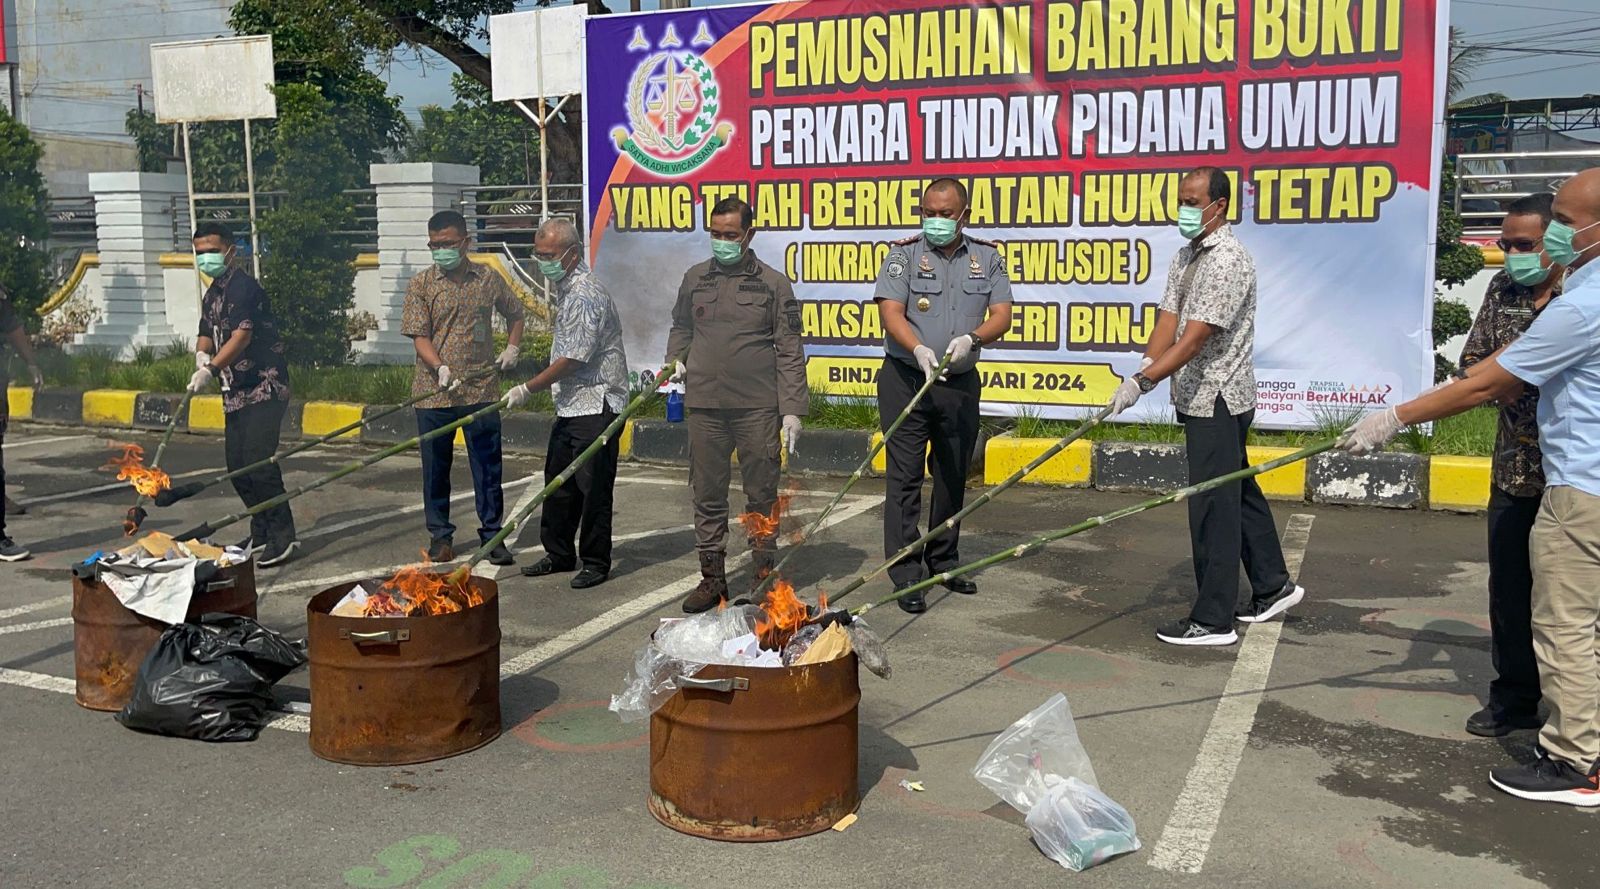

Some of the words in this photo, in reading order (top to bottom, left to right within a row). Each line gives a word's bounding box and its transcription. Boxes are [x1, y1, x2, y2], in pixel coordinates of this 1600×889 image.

[751, 5, 1031, 89] PEMUSNAHAN
[1048, 0, 1236, 73] BARANG
[1253, 0, 1399, 59] BUKTI
[752, 102, 909, 165] PERKARA
[920, 94, 1058, 160] TINDAK
[1071, 86, 1227, 155] PIDANA
[1241, 76, 1398, 149] UMUM
[628, 144, 649, 167] SATYA
[650, 162, 669, 172] ADHI
[672, 141, 716, 172] WICAKSANA
[612, 184, 691, 228] YANG
[812, 175, 1069, 227] BERKEATAN
[1254, 166, 1393, 220] TETAP
[997, 242, 1128, 282] EWIJSDE
[1032, 373, 1086, 391] 2024
[1306, 391, 1387, 404] BerAKHLAK
